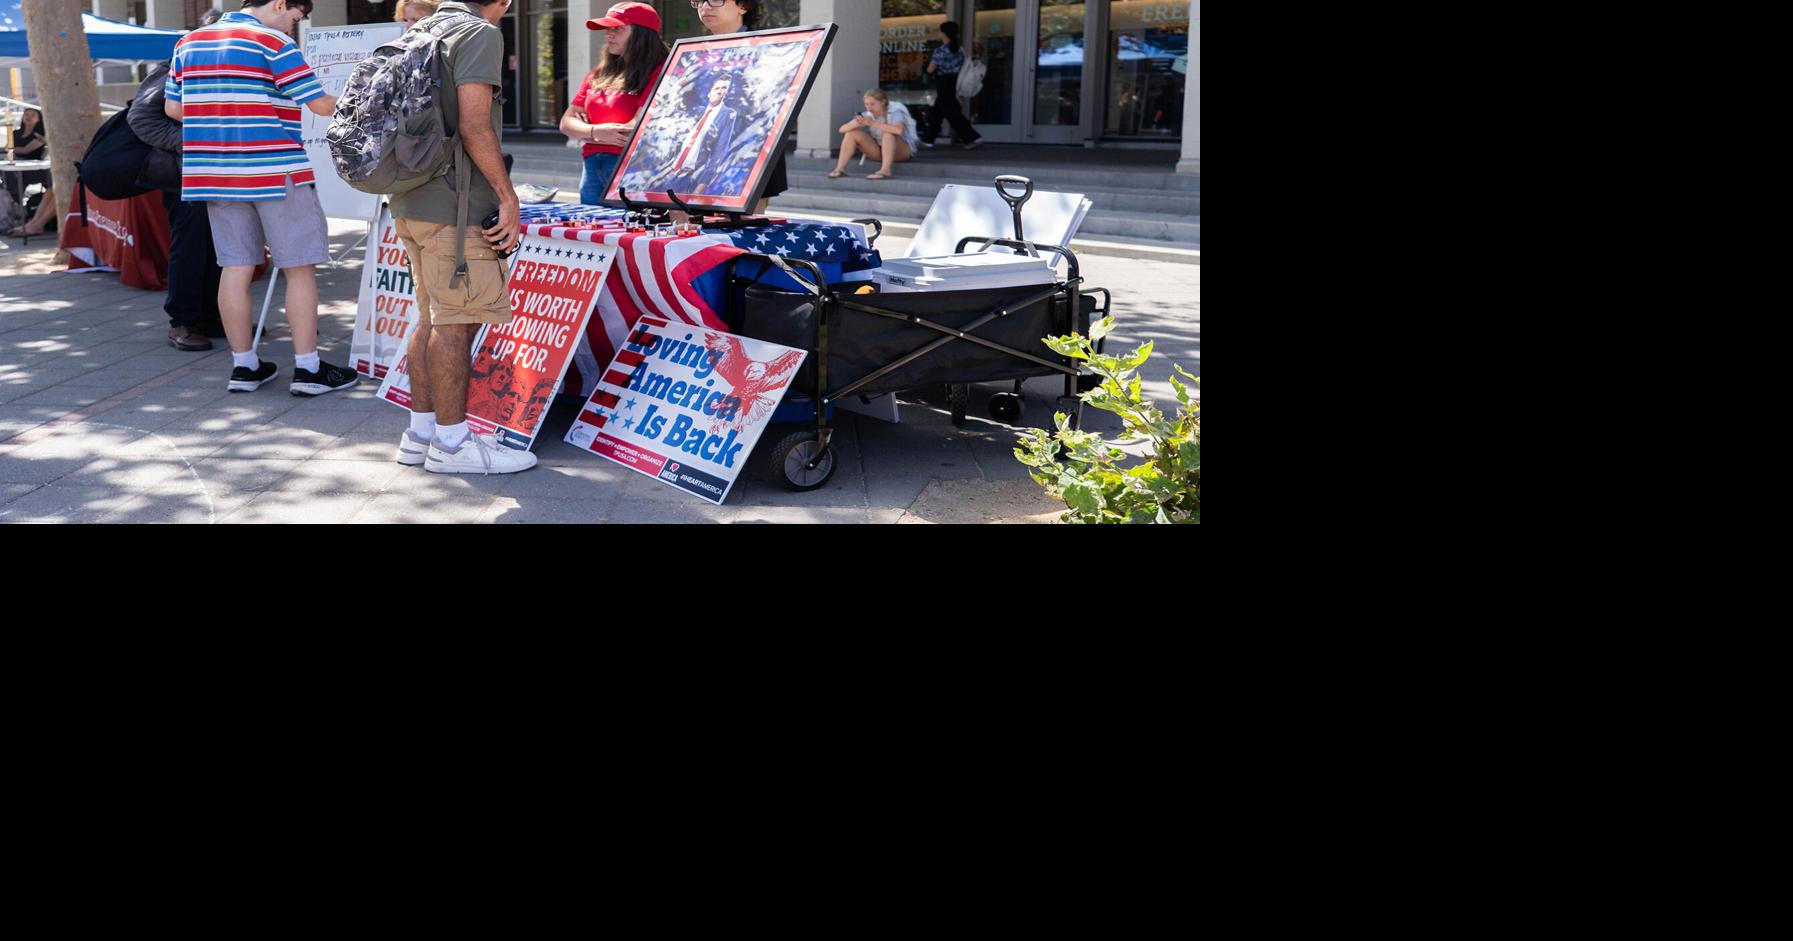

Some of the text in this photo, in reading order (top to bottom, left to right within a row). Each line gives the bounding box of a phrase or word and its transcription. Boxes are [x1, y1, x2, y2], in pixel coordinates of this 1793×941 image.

[879, 24, 925, 39] ORDER
[513, 259, 603, 293] FREEDOM
[376, 294, 413, 317] OUT
[523, 292, 584, 323] WORTH
[491, 338, 549, 373] UP FOR.
[627, 324, 724, 379] Loving
[628, 362, 742, 423] America
[633, 404, 744, 468] Is Back
